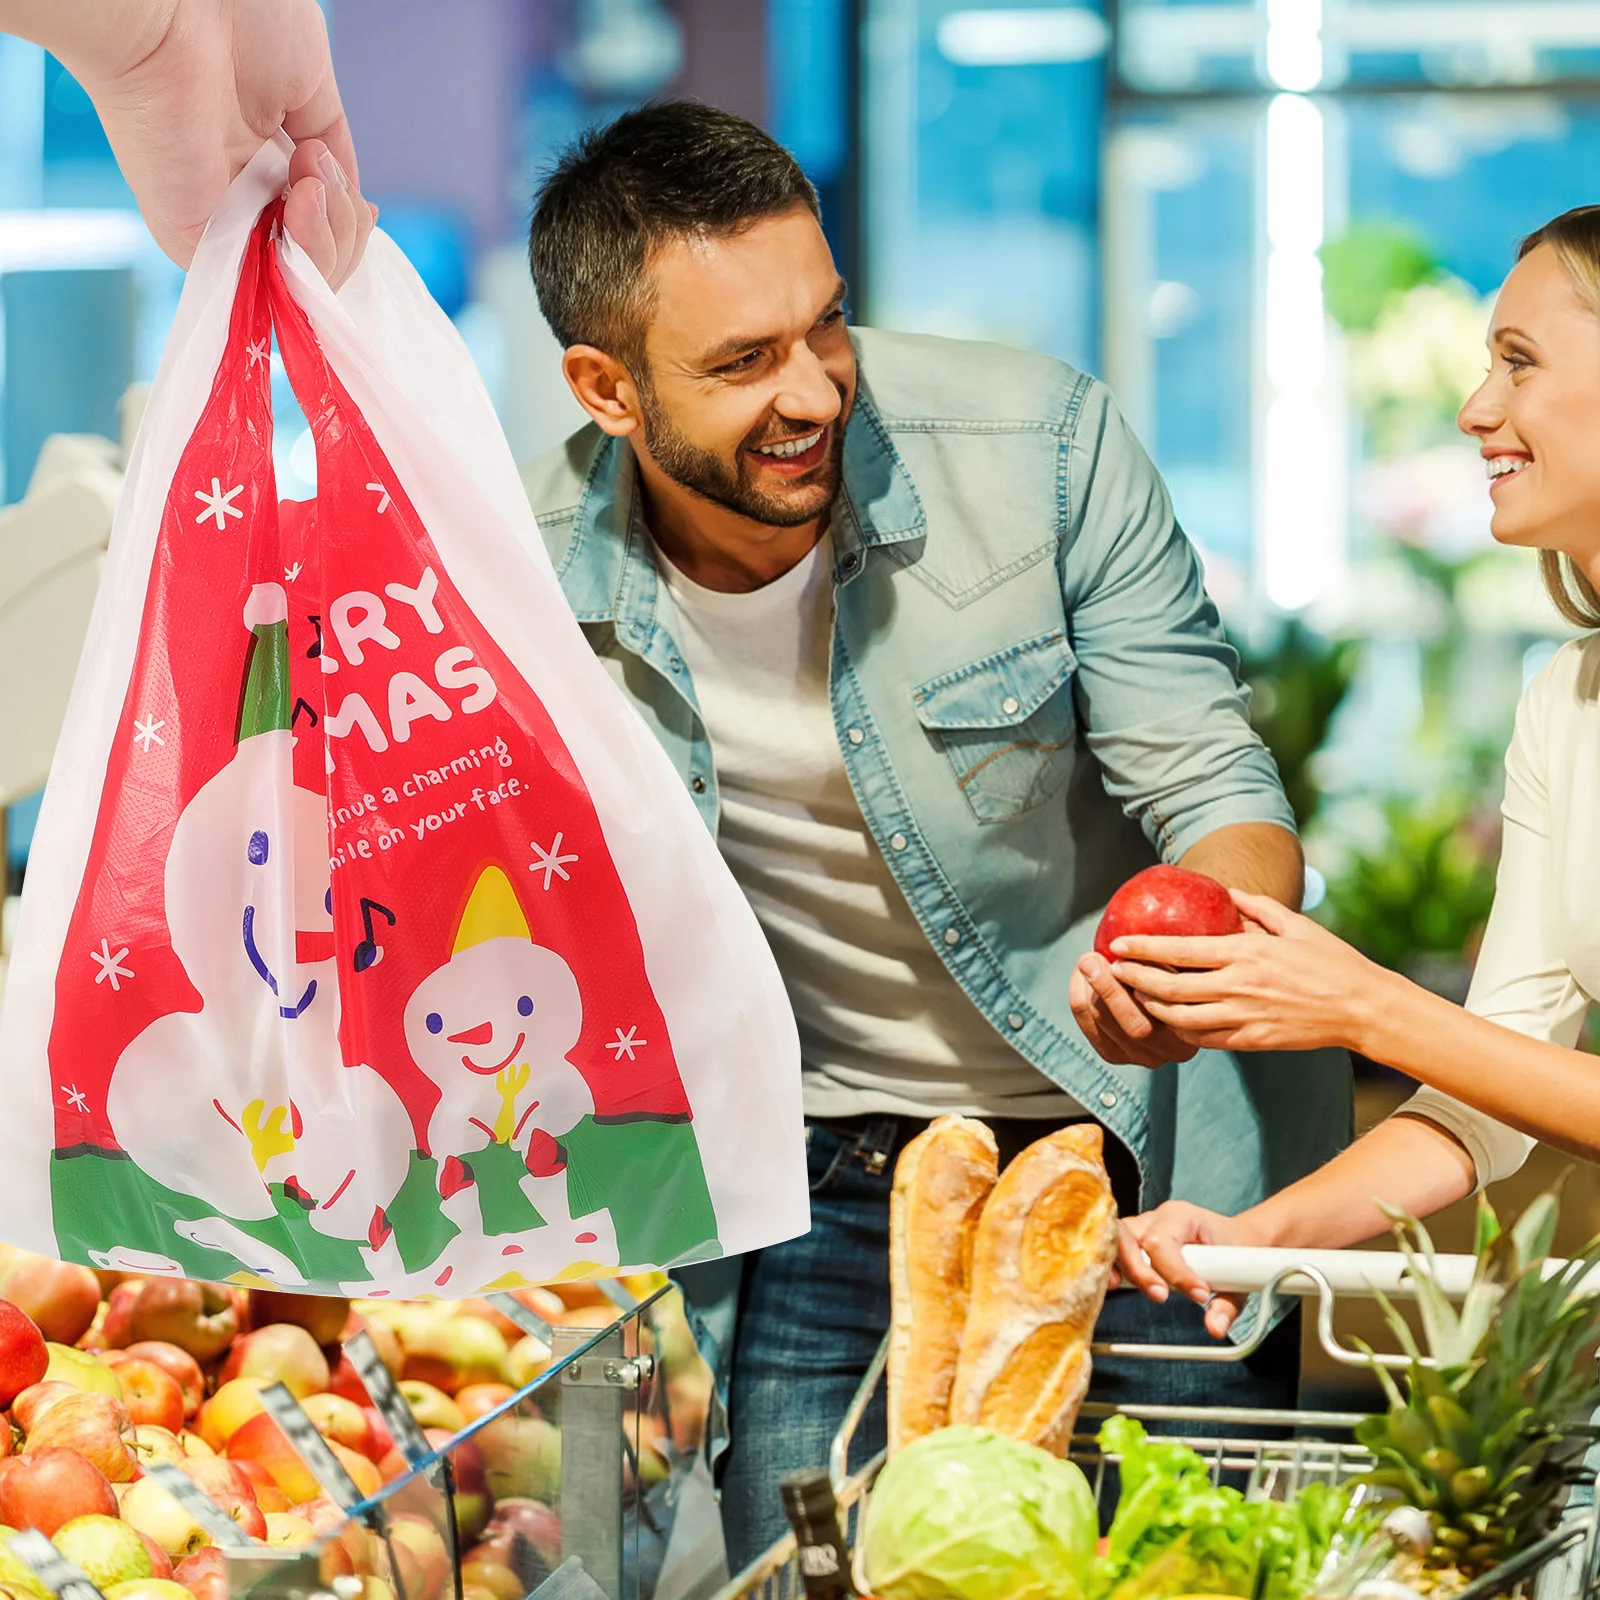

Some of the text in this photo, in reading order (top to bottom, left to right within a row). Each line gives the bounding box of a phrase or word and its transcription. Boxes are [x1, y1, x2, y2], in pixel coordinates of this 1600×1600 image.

[321, 566, 444, 674] RY
[381, 786, 399, 804] a
[402, 735, 512, 797] charming
[377, 828, 405, 850] on
[409, 802, 467, 841] your
[470, 778, 530, 811] face.
